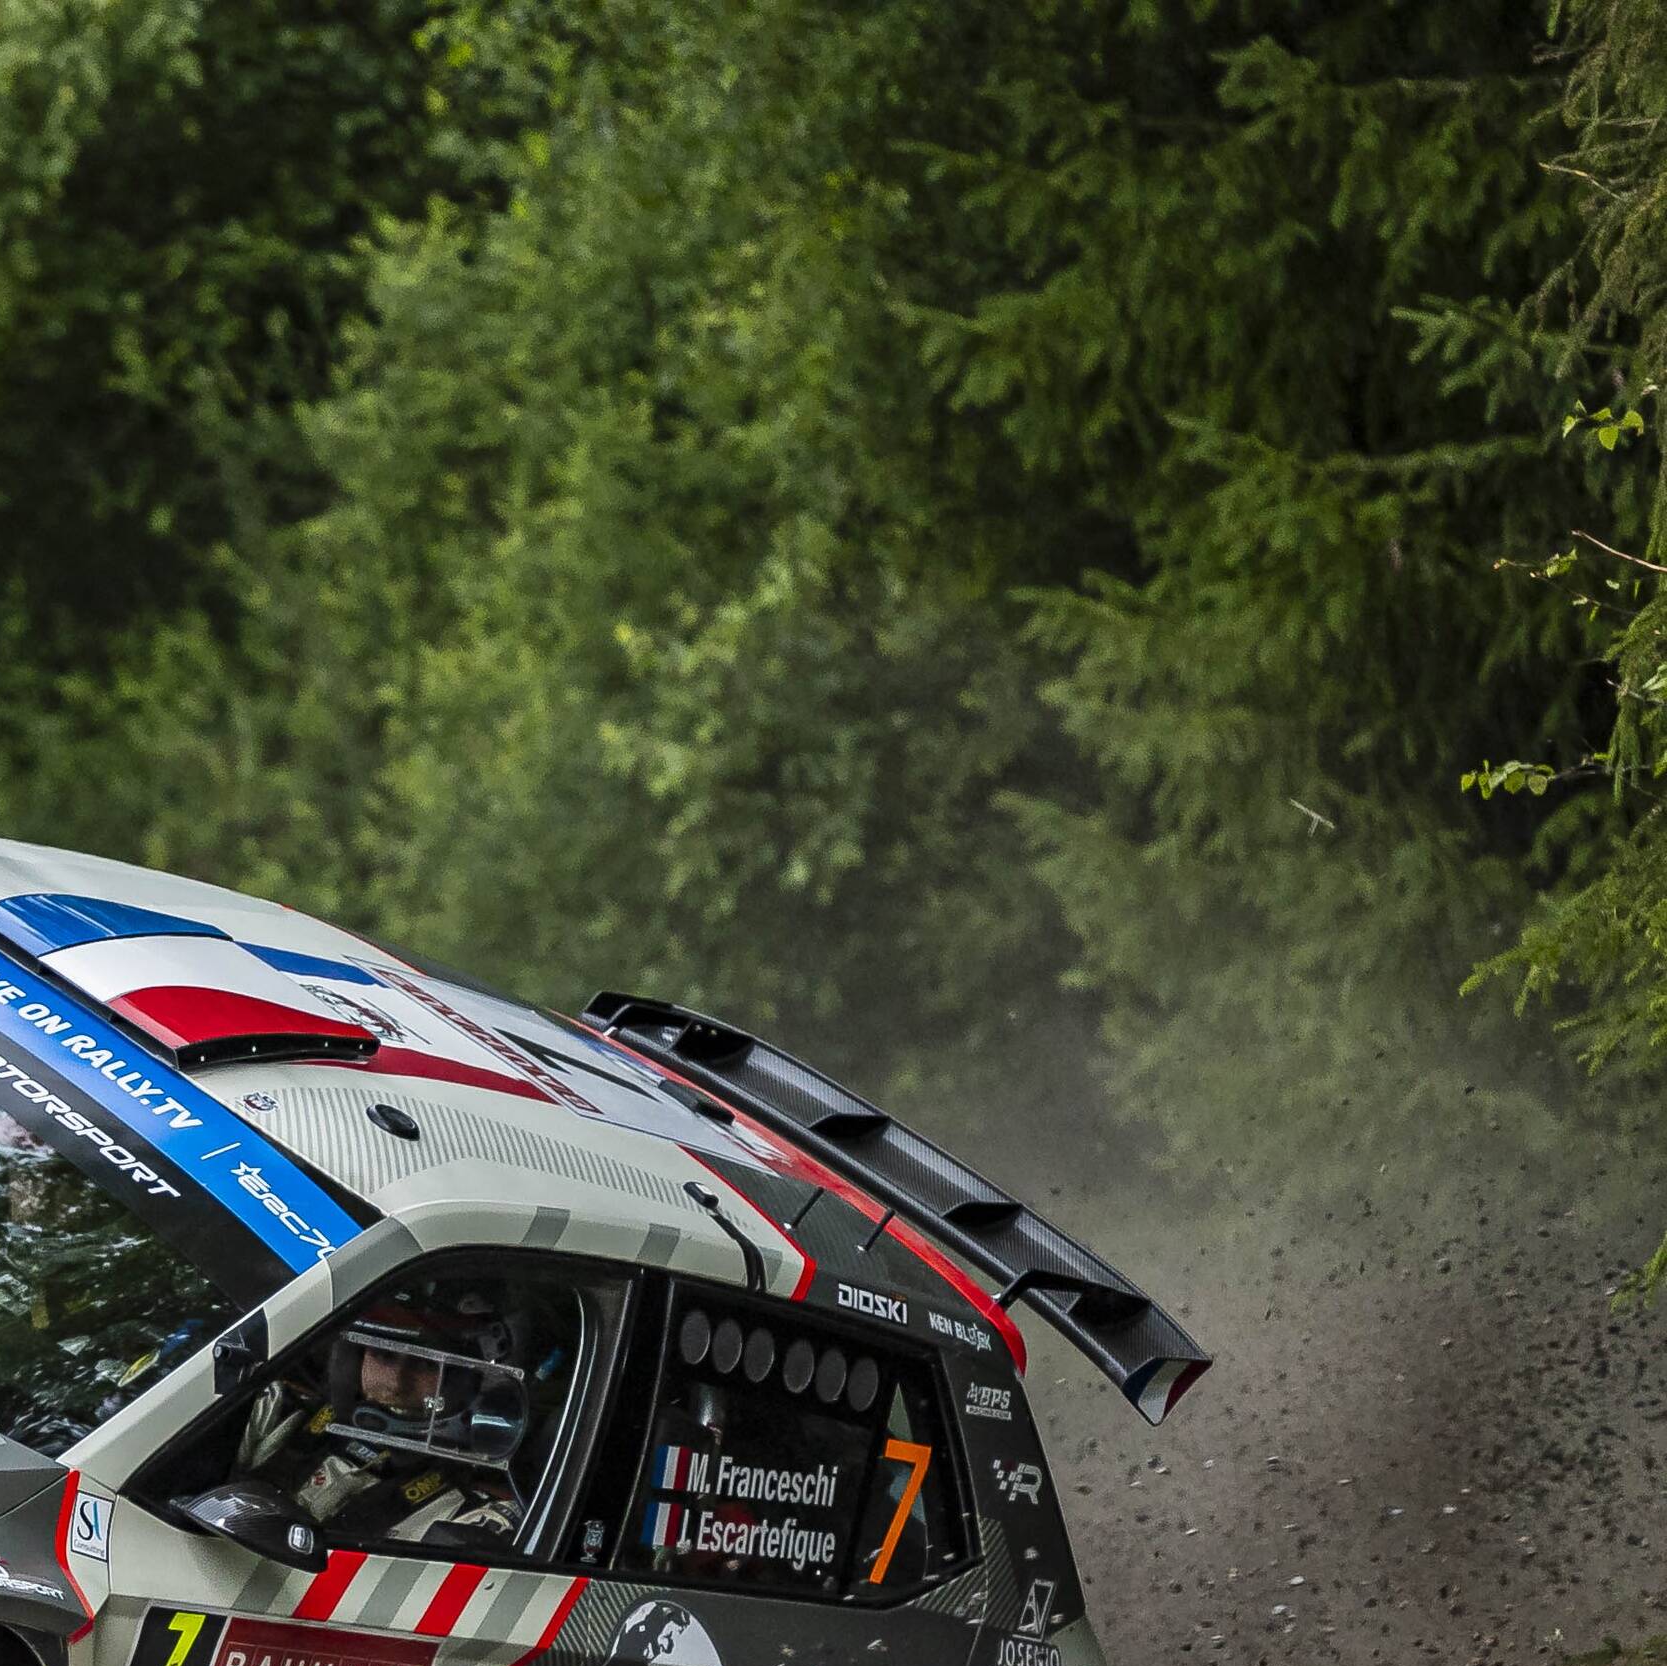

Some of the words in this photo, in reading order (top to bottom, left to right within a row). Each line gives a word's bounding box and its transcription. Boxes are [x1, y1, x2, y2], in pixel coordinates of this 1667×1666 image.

[18, 1003, 72, 1035] ON
[61, 1034, 203, 1129] RALLY.TV
[838, 1283, 908, 1325] DIOSKI
[929, 1312, 953, 1336] KEN
[979, 1386, 1012, 1410] BPS
[687, 1452, 710, 1494] M.
[717, 1456, 839, 1507] Franceschi
[869, 1439, 932, 1585] 7
[697, 1511, 836, 1571] Escartefigue
